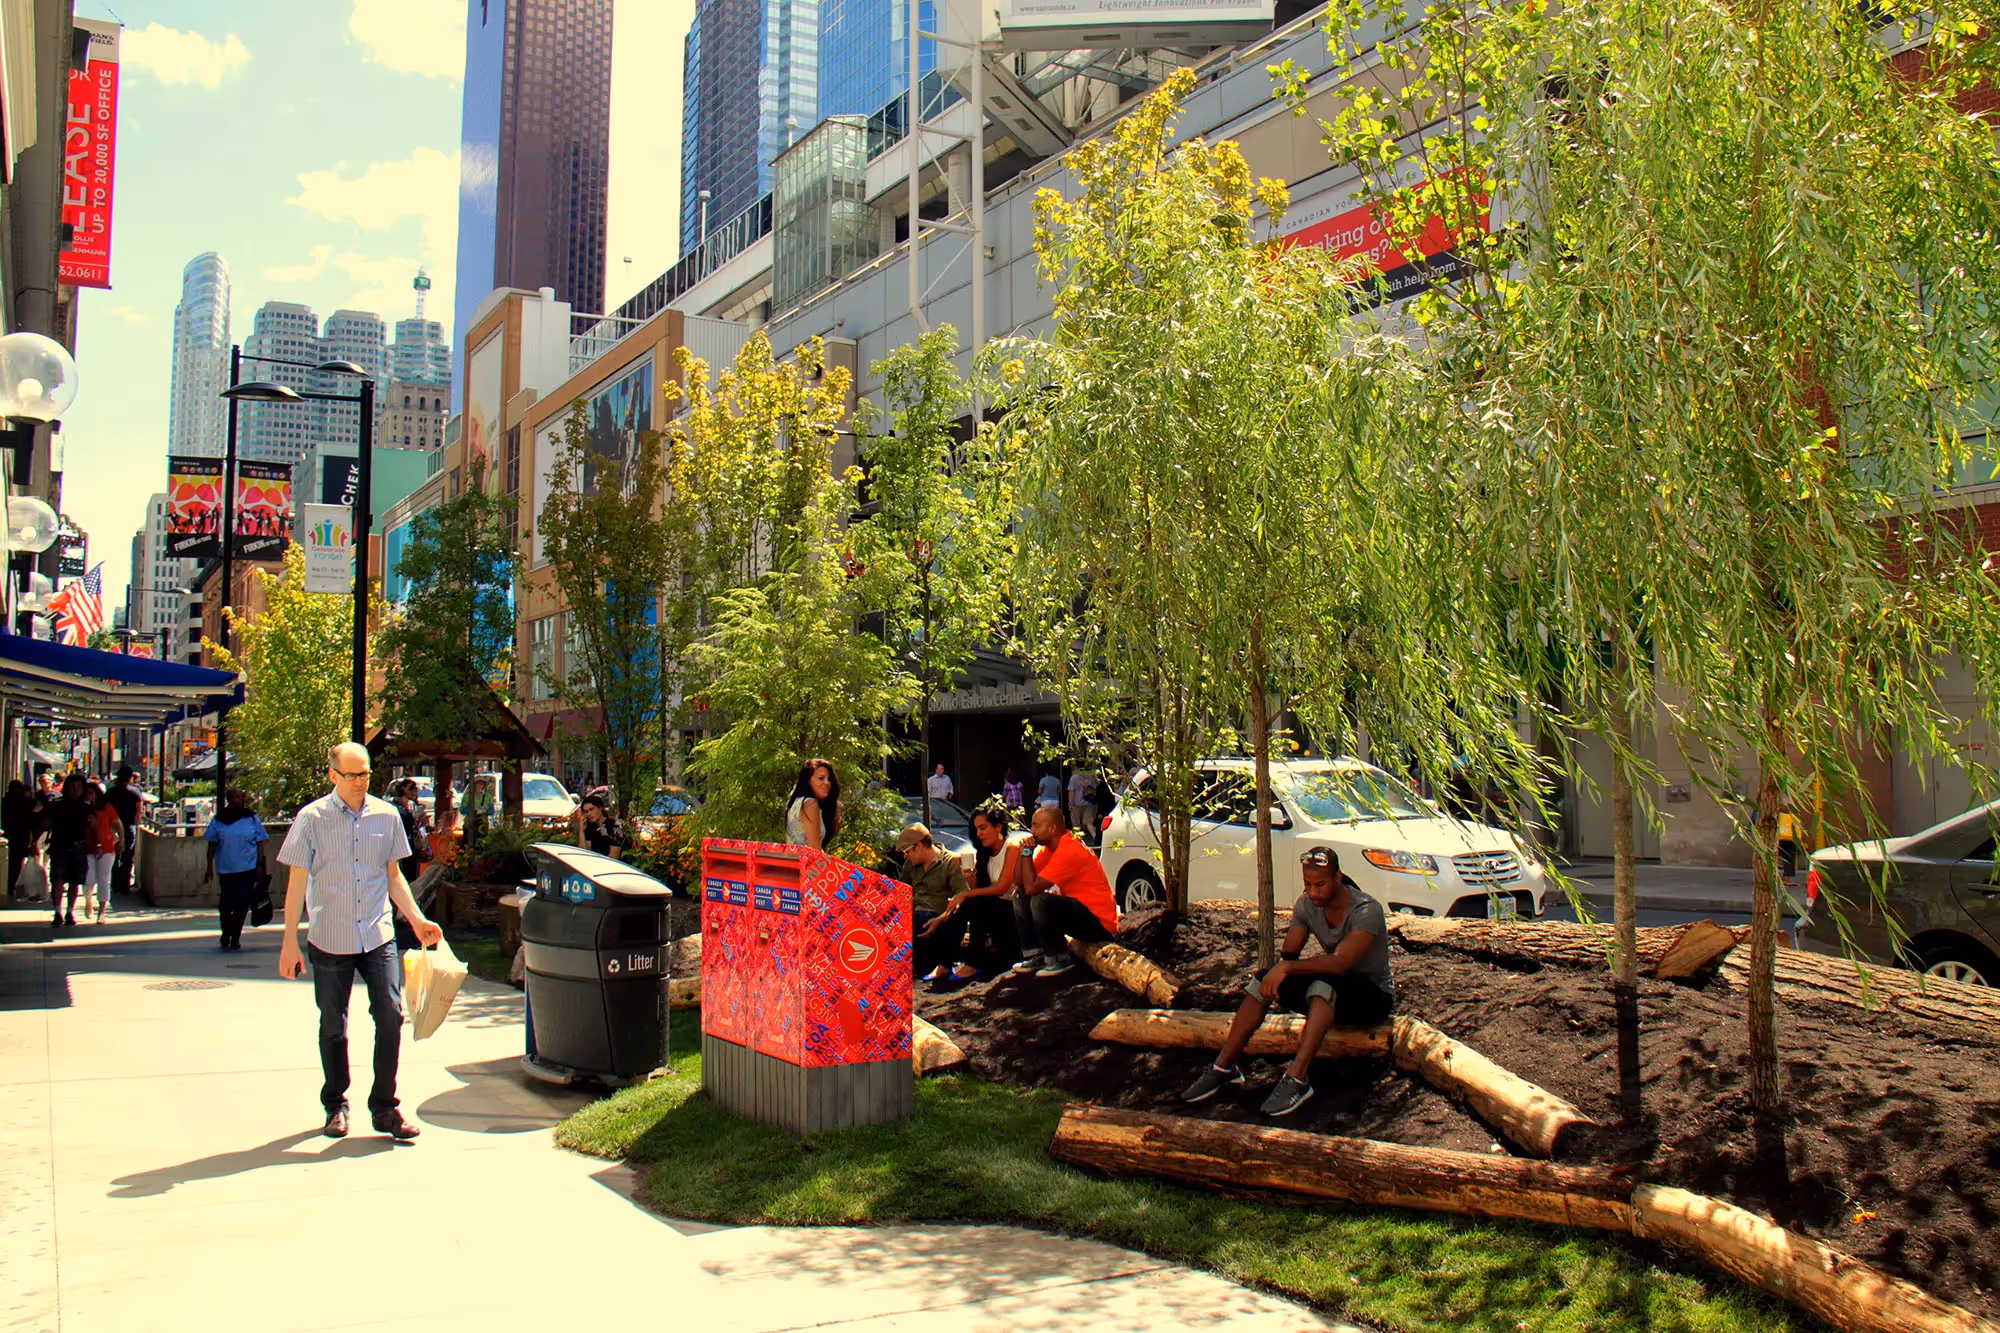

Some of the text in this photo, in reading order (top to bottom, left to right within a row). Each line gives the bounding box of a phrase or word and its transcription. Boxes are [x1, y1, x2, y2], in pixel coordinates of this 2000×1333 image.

[92, 68, 112, 233] UP TO 20,000 SF OFFICE
[1286, 207, 1331, 230] CANADIAN
[817, 861, 850, 897] P9A
[782, 902, 799, 911] CANADA
[628, 954, 655, 971] Litter
